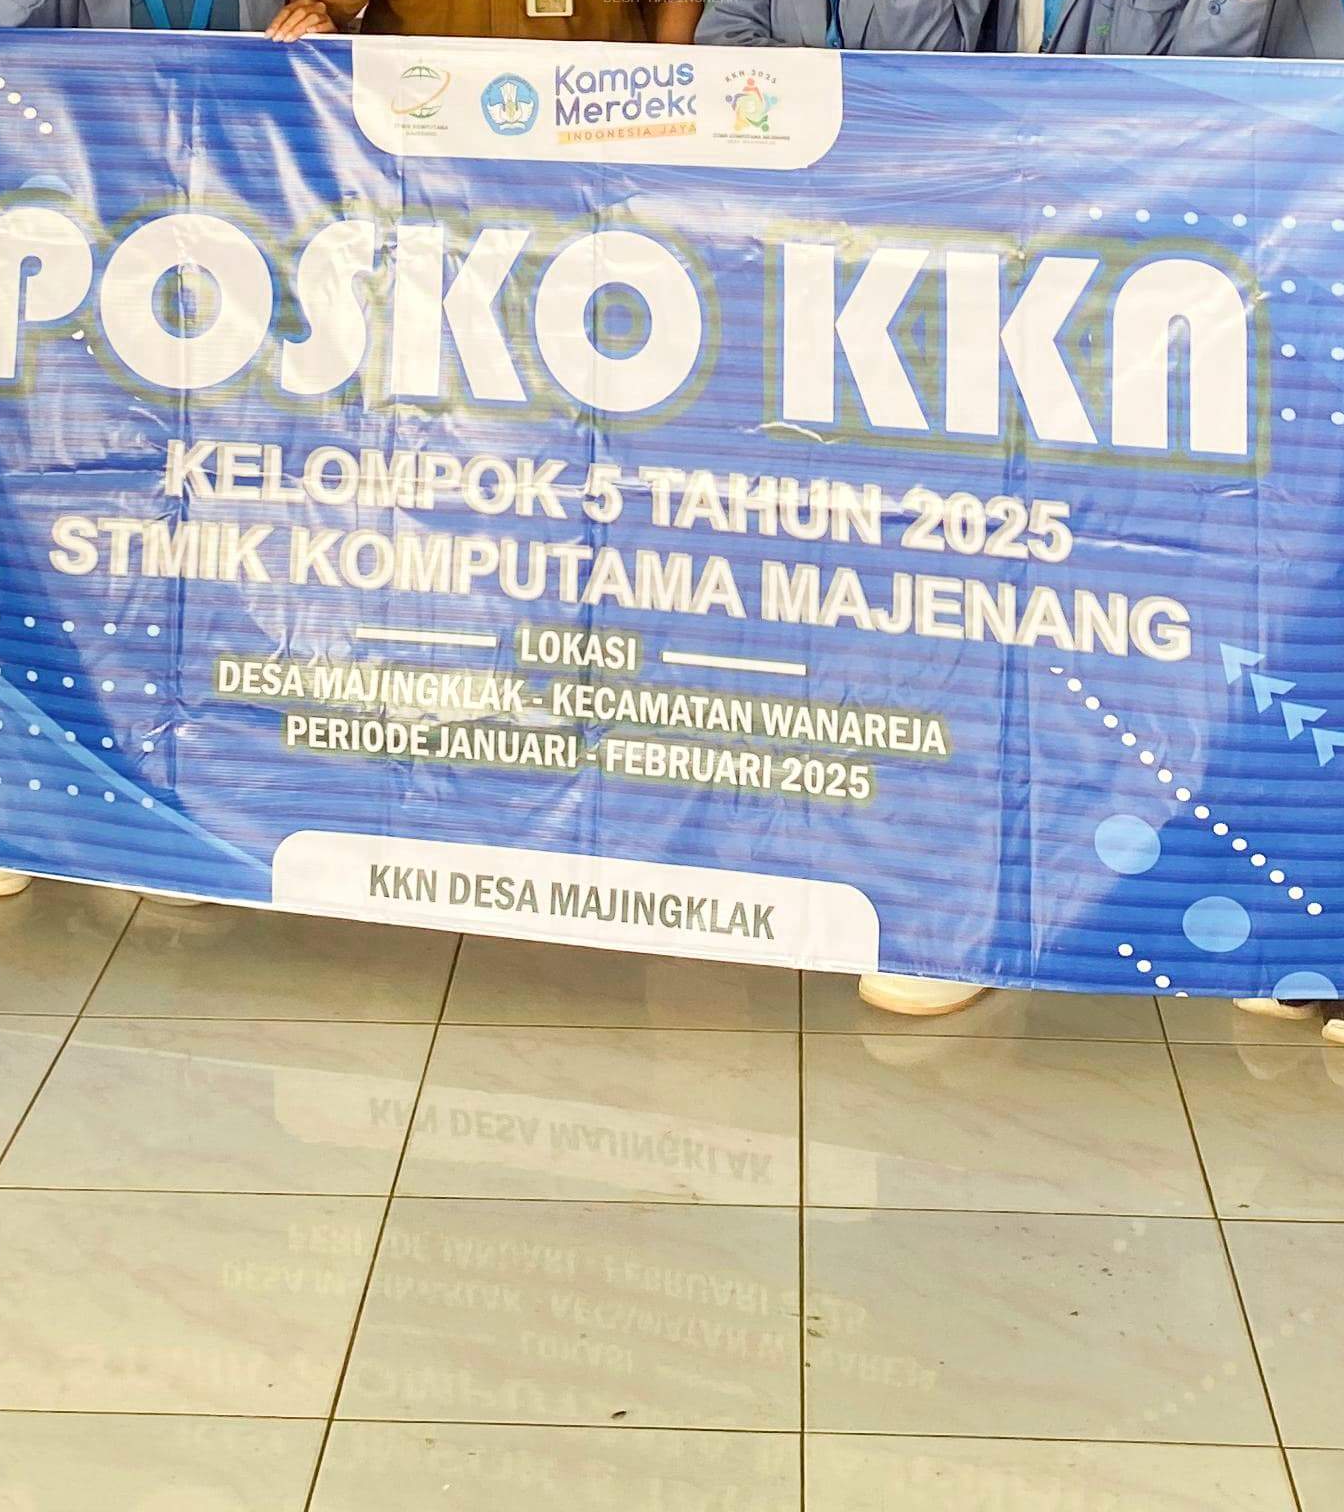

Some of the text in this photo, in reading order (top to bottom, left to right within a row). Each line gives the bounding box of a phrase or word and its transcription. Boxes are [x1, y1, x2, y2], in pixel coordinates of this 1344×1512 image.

[555, 63, 694, 97] Kampus
[567, 121, 697, 142] INDONESIA JAYA
[783, 242, 1247, 455] KKN
[165, 440, 1074, 564] KELOMPOK 5 TAHUN 2025
[49, 516, 1193, 662] STMIK KOMPUTAMA MAJENANG
[520, 628, 637, 671] LOKASI
[218, 659, 305, 698] DESA
[312, 667, 525, 713] MAJINGKLAK
[553, 683, 752, 736] KECAMATAN
[762, 702, 947, 756] WANAREJA
[286, 716, 430, 759] PERIODE
[436, 726, 578, 769] JANUARI
[606, 740, 772, 790] FEBRUARI
[782, 756, 871, 800] 2025
[369, 864, 776, 940] KKN DESA MAJINGKLAK
